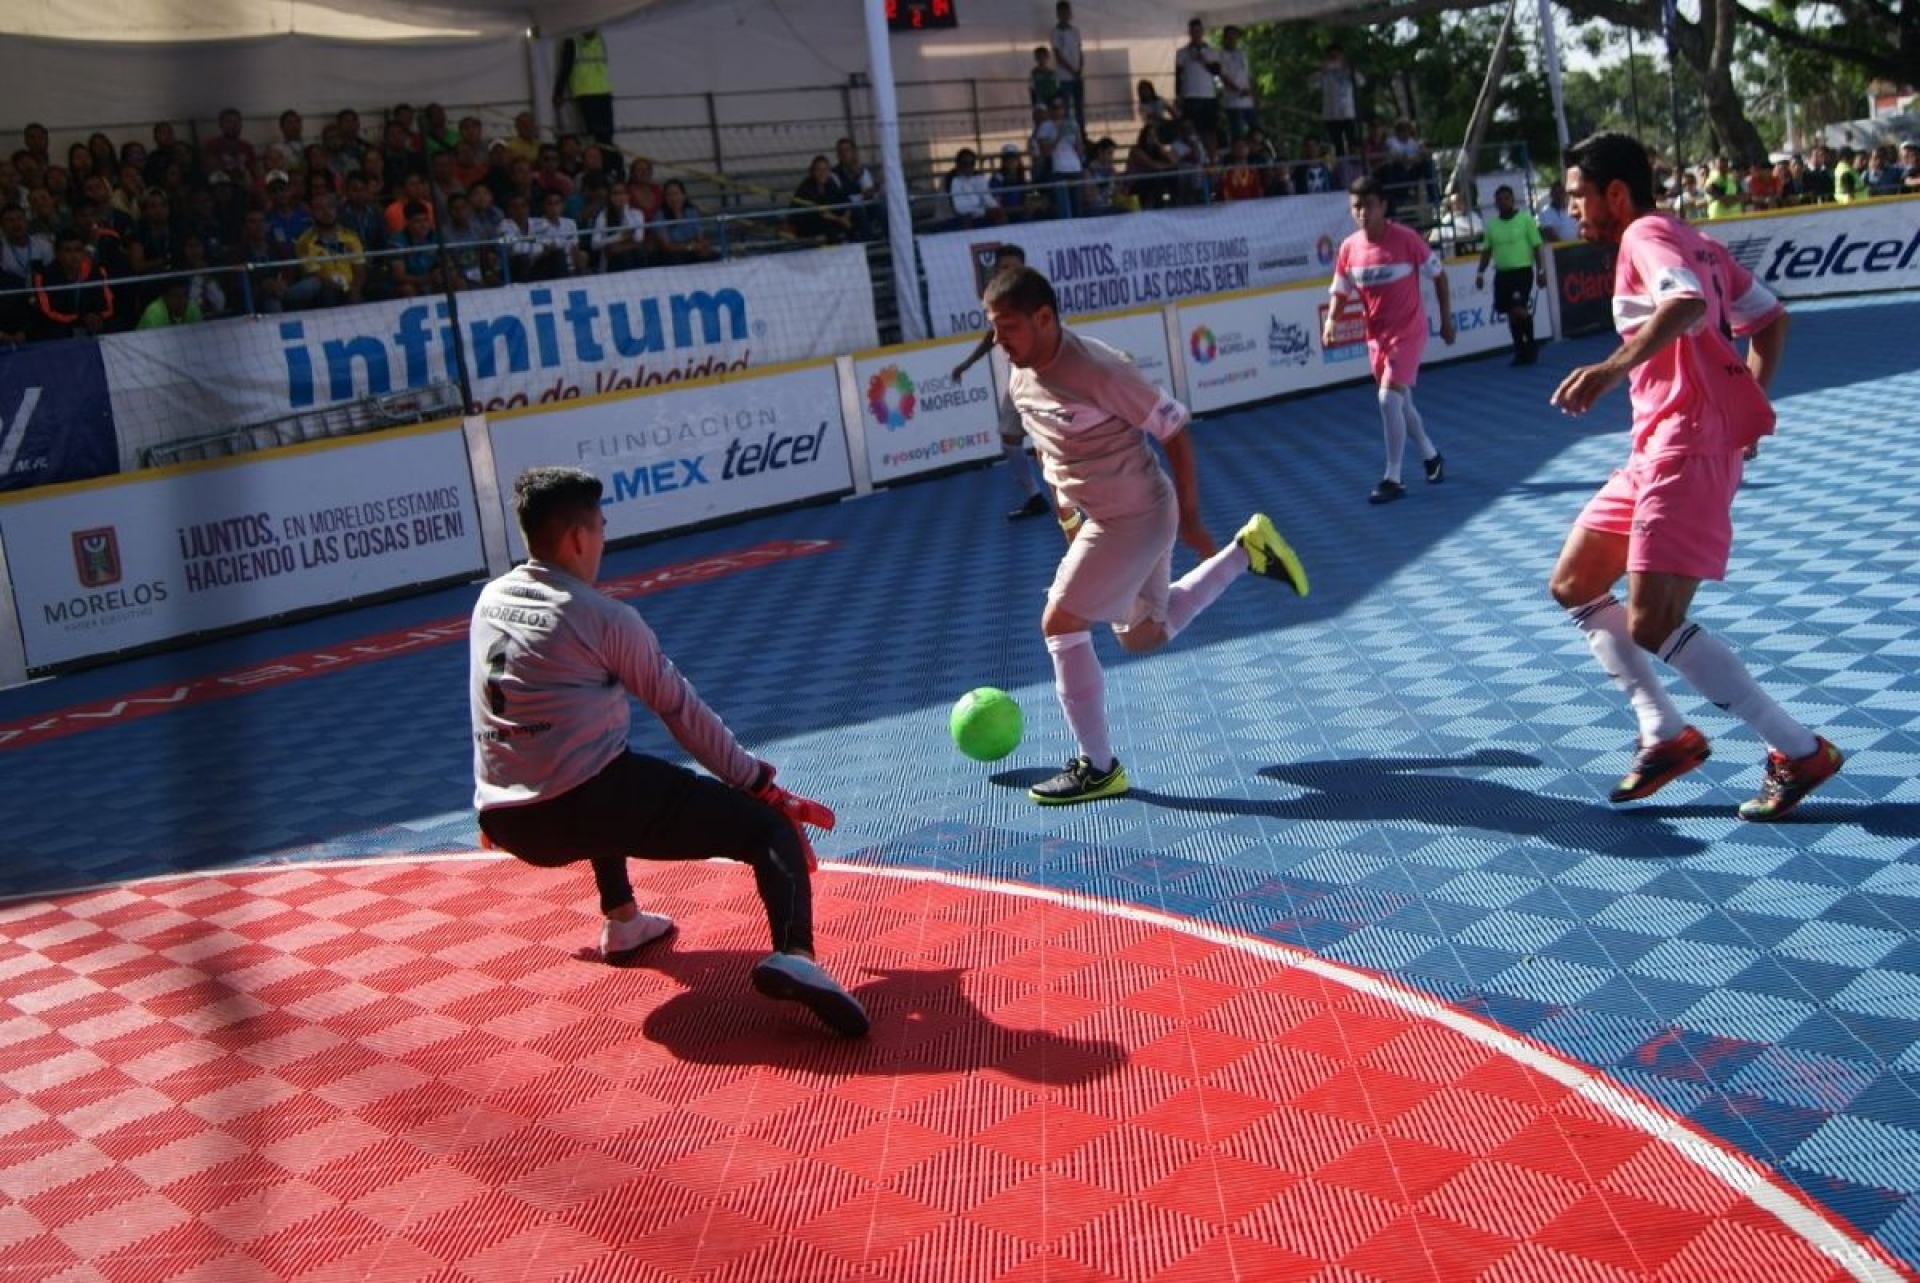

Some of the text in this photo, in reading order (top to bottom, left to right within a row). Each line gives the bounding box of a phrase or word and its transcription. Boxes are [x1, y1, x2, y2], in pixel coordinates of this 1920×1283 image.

[1122, 248, 1139, 273] EN
[1140, 241, 1194, 268] MORELOS
[1197, 236, 1249, 264] ESTAMOS
[1765, 227, 1920, 282] telcel
[1133, 271, 1160, 302] LAS
[1165, 265, 1212, 297] COSAS
[279, 286, 748, 409] infinitum
[919, 386, 988, 412] MORELOS
[721, 421, 828, 481] telcel
[284, 515, 307, 541] EN
[309, 501, 385, 535] MORELOS
[387, 485, 460, 519] ESTAMOS
[184, 511, 466, 593] HACIENDO LAS COSAS BIEN!
[43, 581, 168, 625] MORELOS
